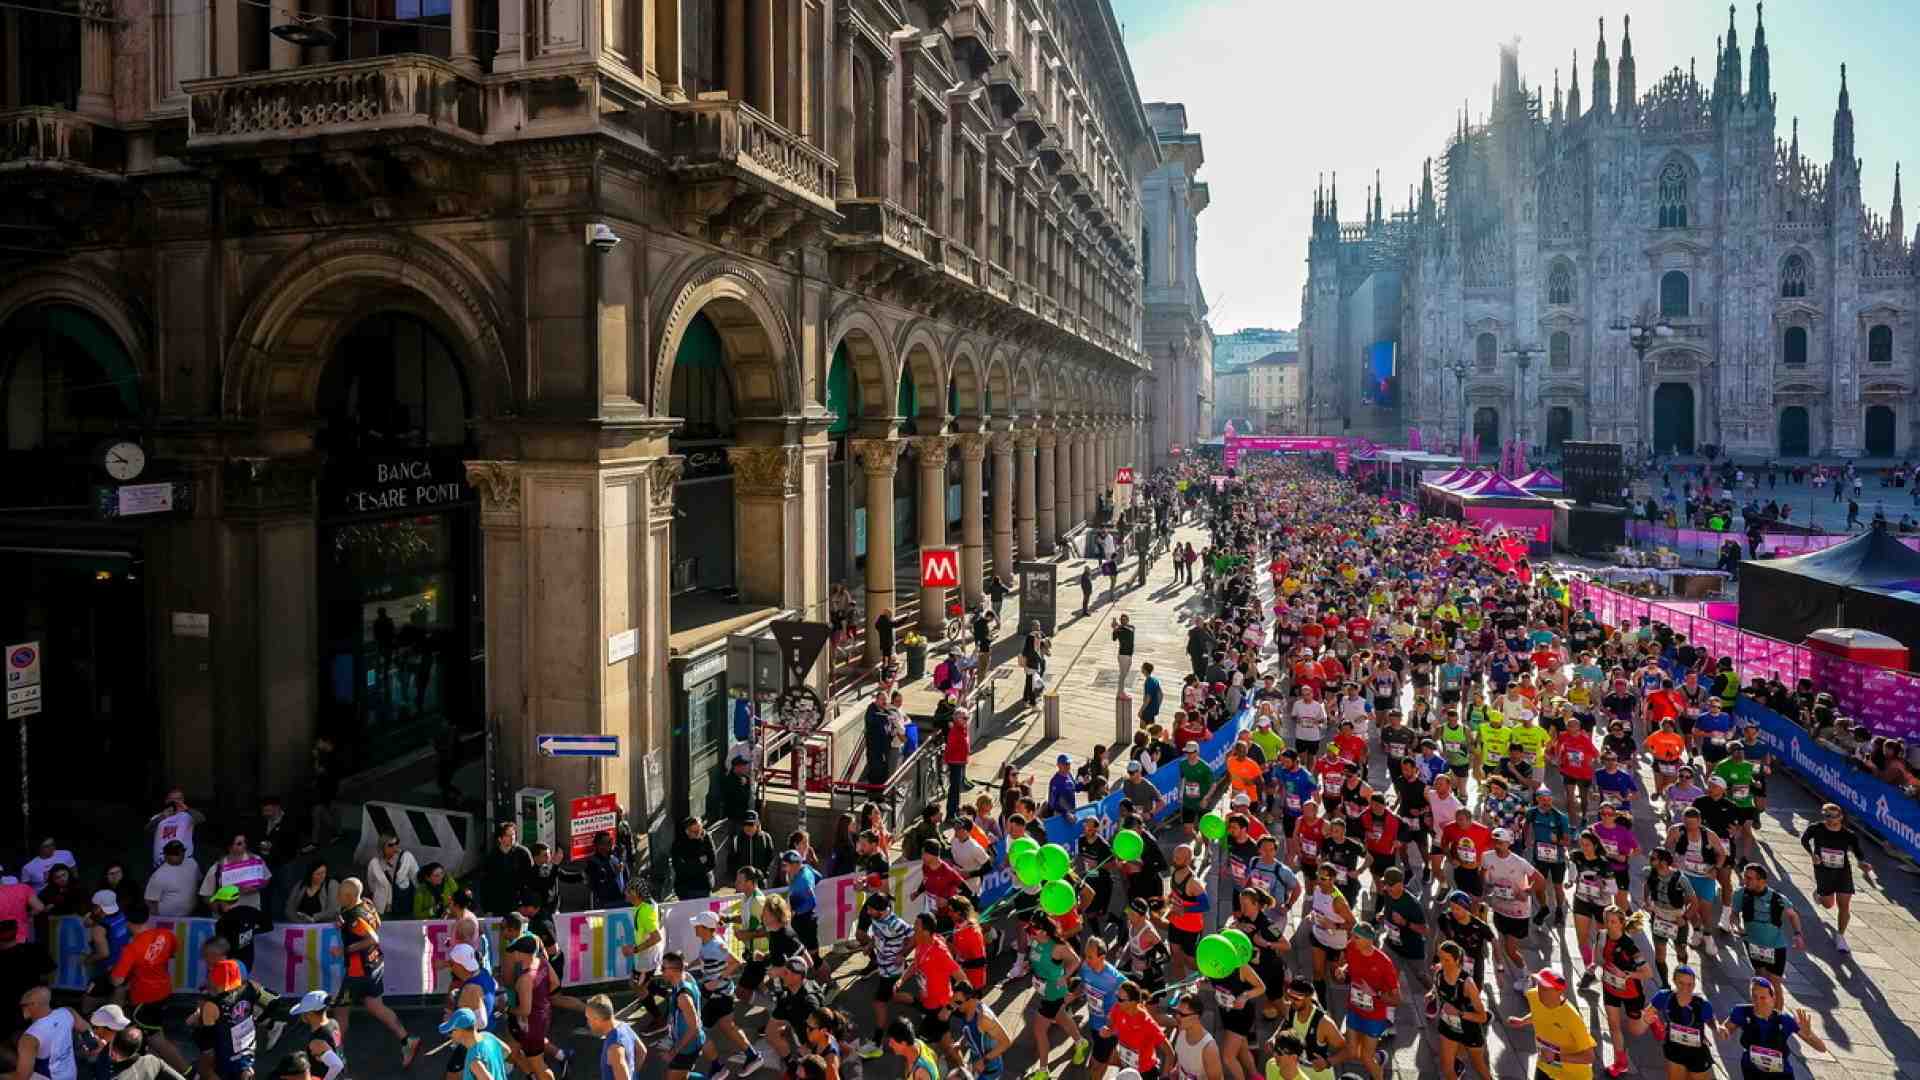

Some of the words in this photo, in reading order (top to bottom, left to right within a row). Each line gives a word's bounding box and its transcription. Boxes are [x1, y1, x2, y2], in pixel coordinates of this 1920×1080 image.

[377, 460, 432, 482] BANCA
[415, 482, 460, 505] PONTI
[925, 557, 954, 580] M
